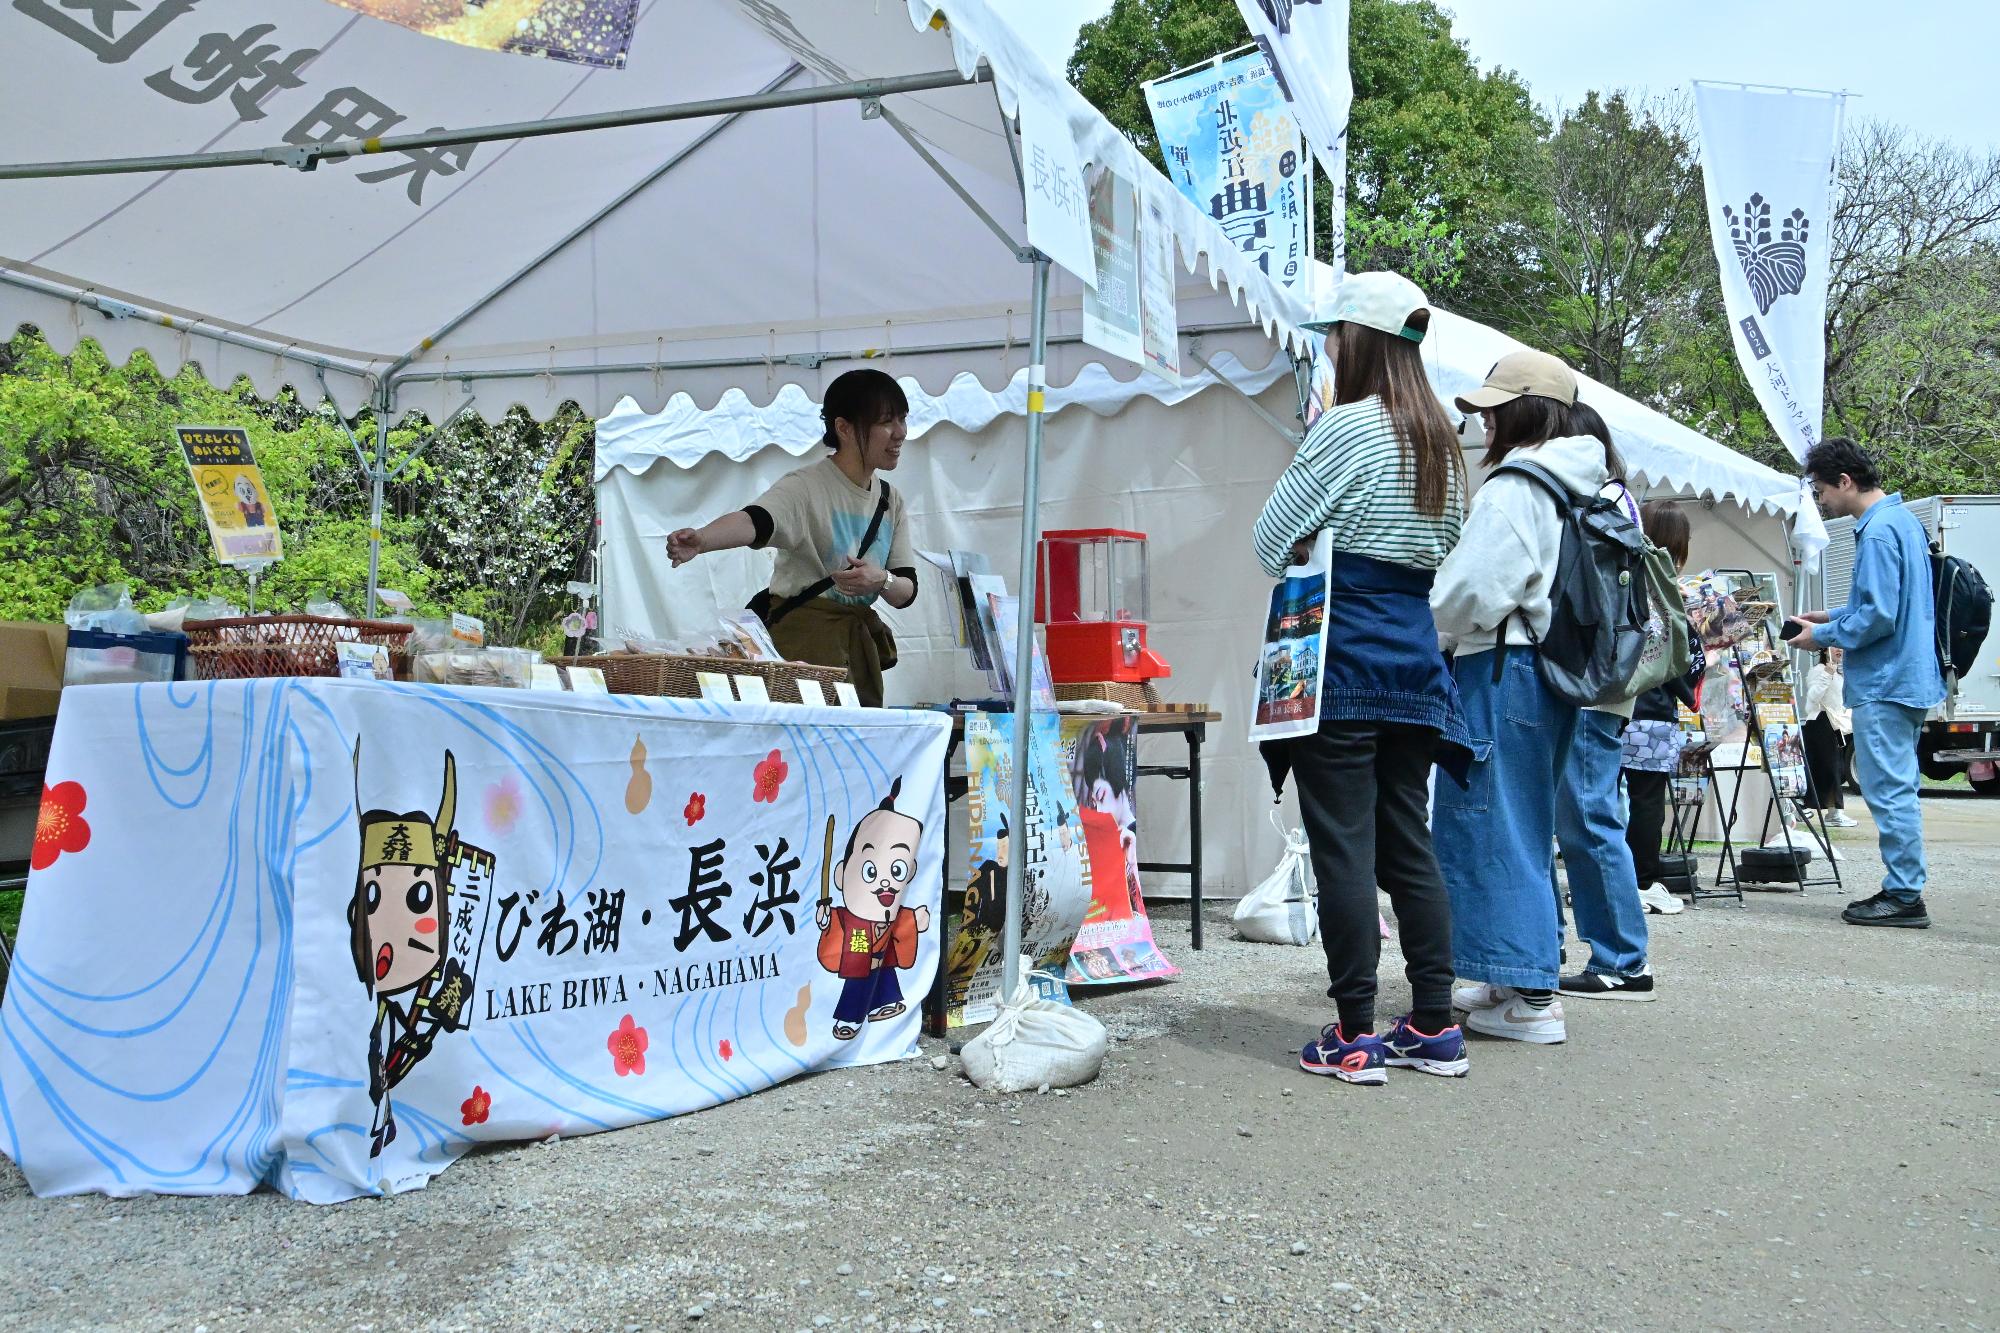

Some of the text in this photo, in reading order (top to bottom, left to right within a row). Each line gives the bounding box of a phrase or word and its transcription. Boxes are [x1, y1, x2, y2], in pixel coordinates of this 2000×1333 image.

[1744, 320, 1766, 356] 2026
[962, 771, 984, 927] HIDENAGA
[453, 874, 481, 974] 三成くん
[496, 837, 801, 963] びわ湖・長浜
[486, 983, 552, 1020] LAKE
